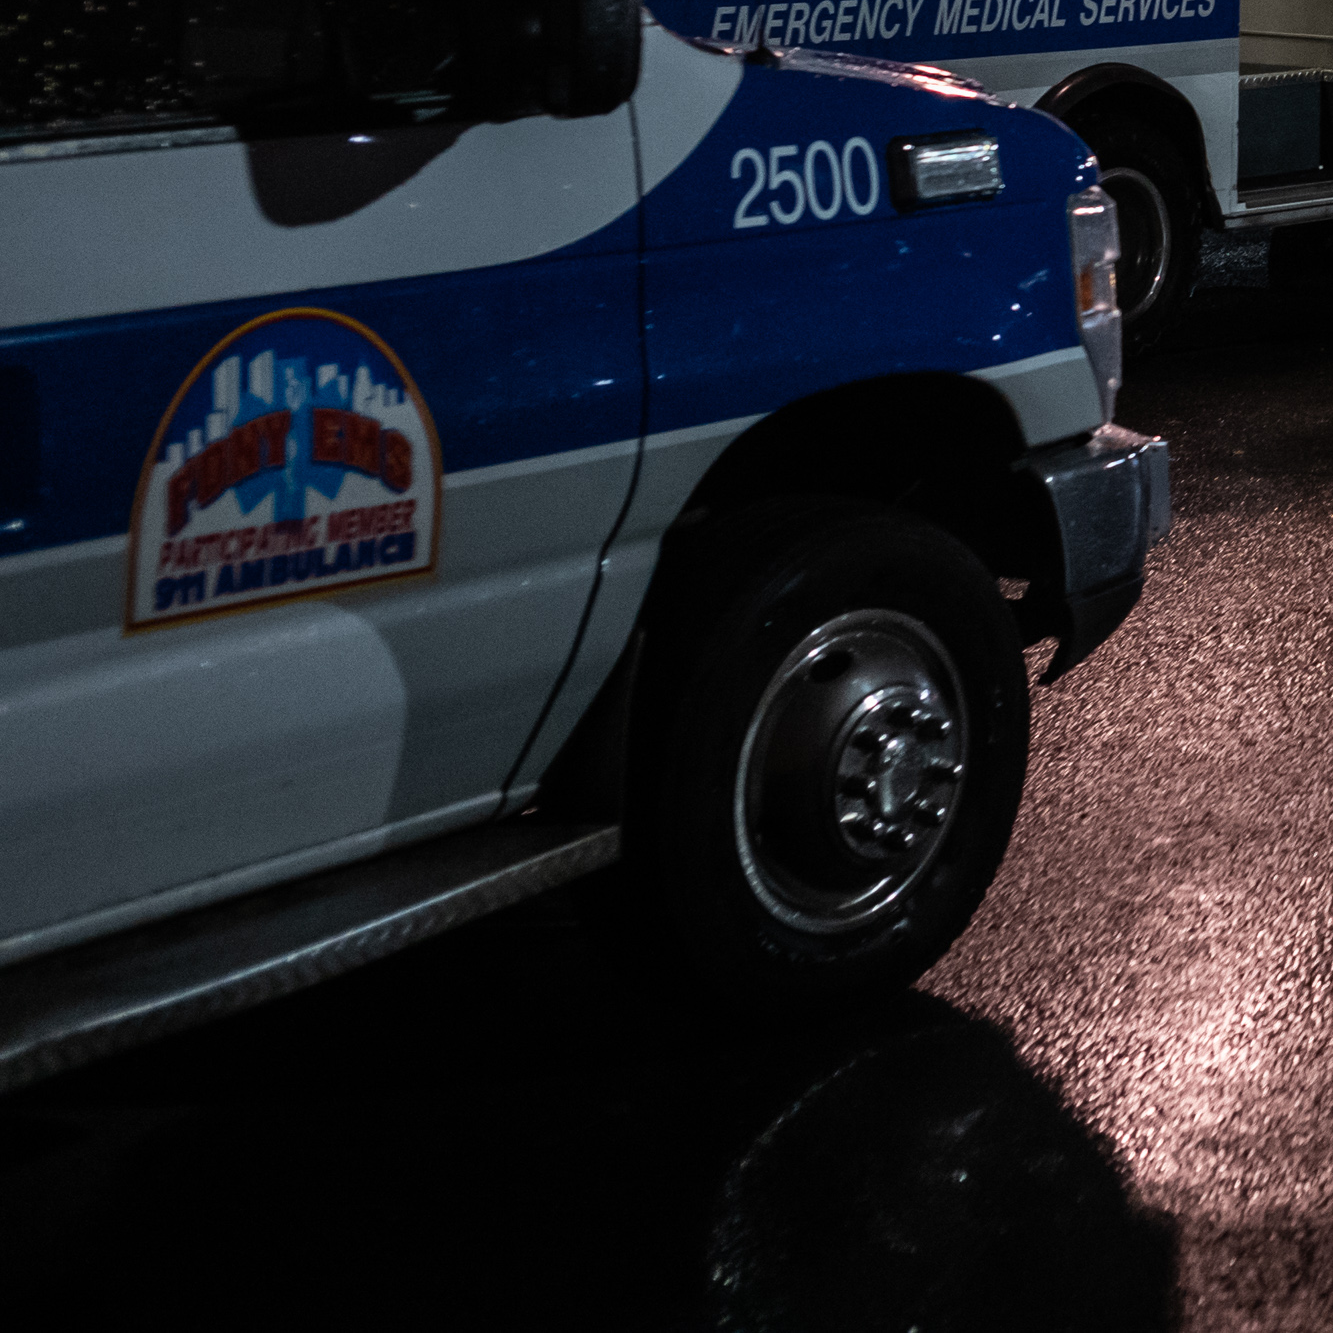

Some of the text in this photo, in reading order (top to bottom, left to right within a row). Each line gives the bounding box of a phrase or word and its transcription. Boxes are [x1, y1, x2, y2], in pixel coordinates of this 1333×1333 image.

[731, 136, 881, 229] 2500
[311, 406, 413, 494] EMS
[157, 499, 417, 570] PARTICIPATING MEMBER
[214, 531, 416, 597] AMBULANCE
